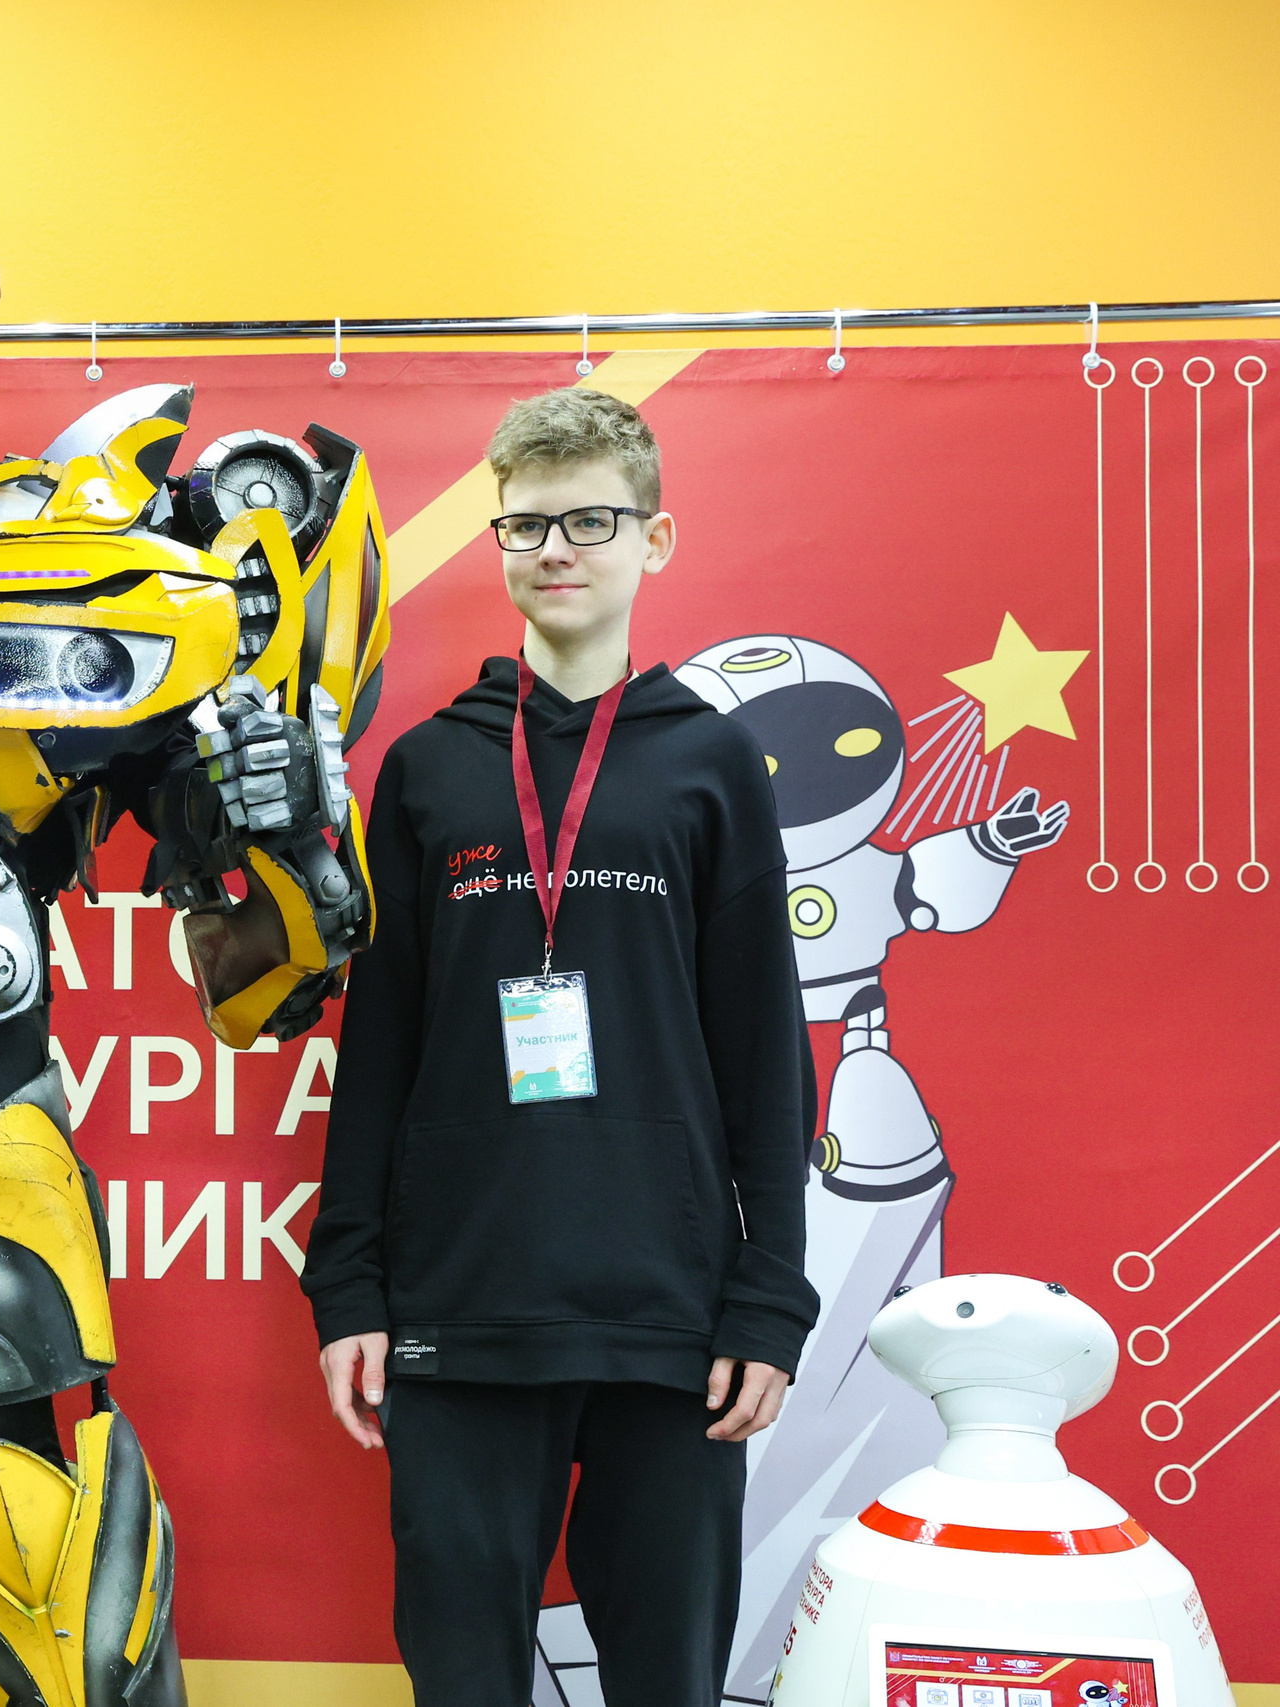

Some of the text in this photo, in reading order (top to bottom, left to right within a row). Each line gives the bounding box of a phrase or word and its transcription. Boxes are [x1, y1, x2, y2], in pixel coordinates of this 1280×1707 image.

[448, 844, 503, 876] уже
[507, 873, 537, 891] не
[516, 1033, 578, 1047] Участник
[107, 1179, 322, 1281] ИК
